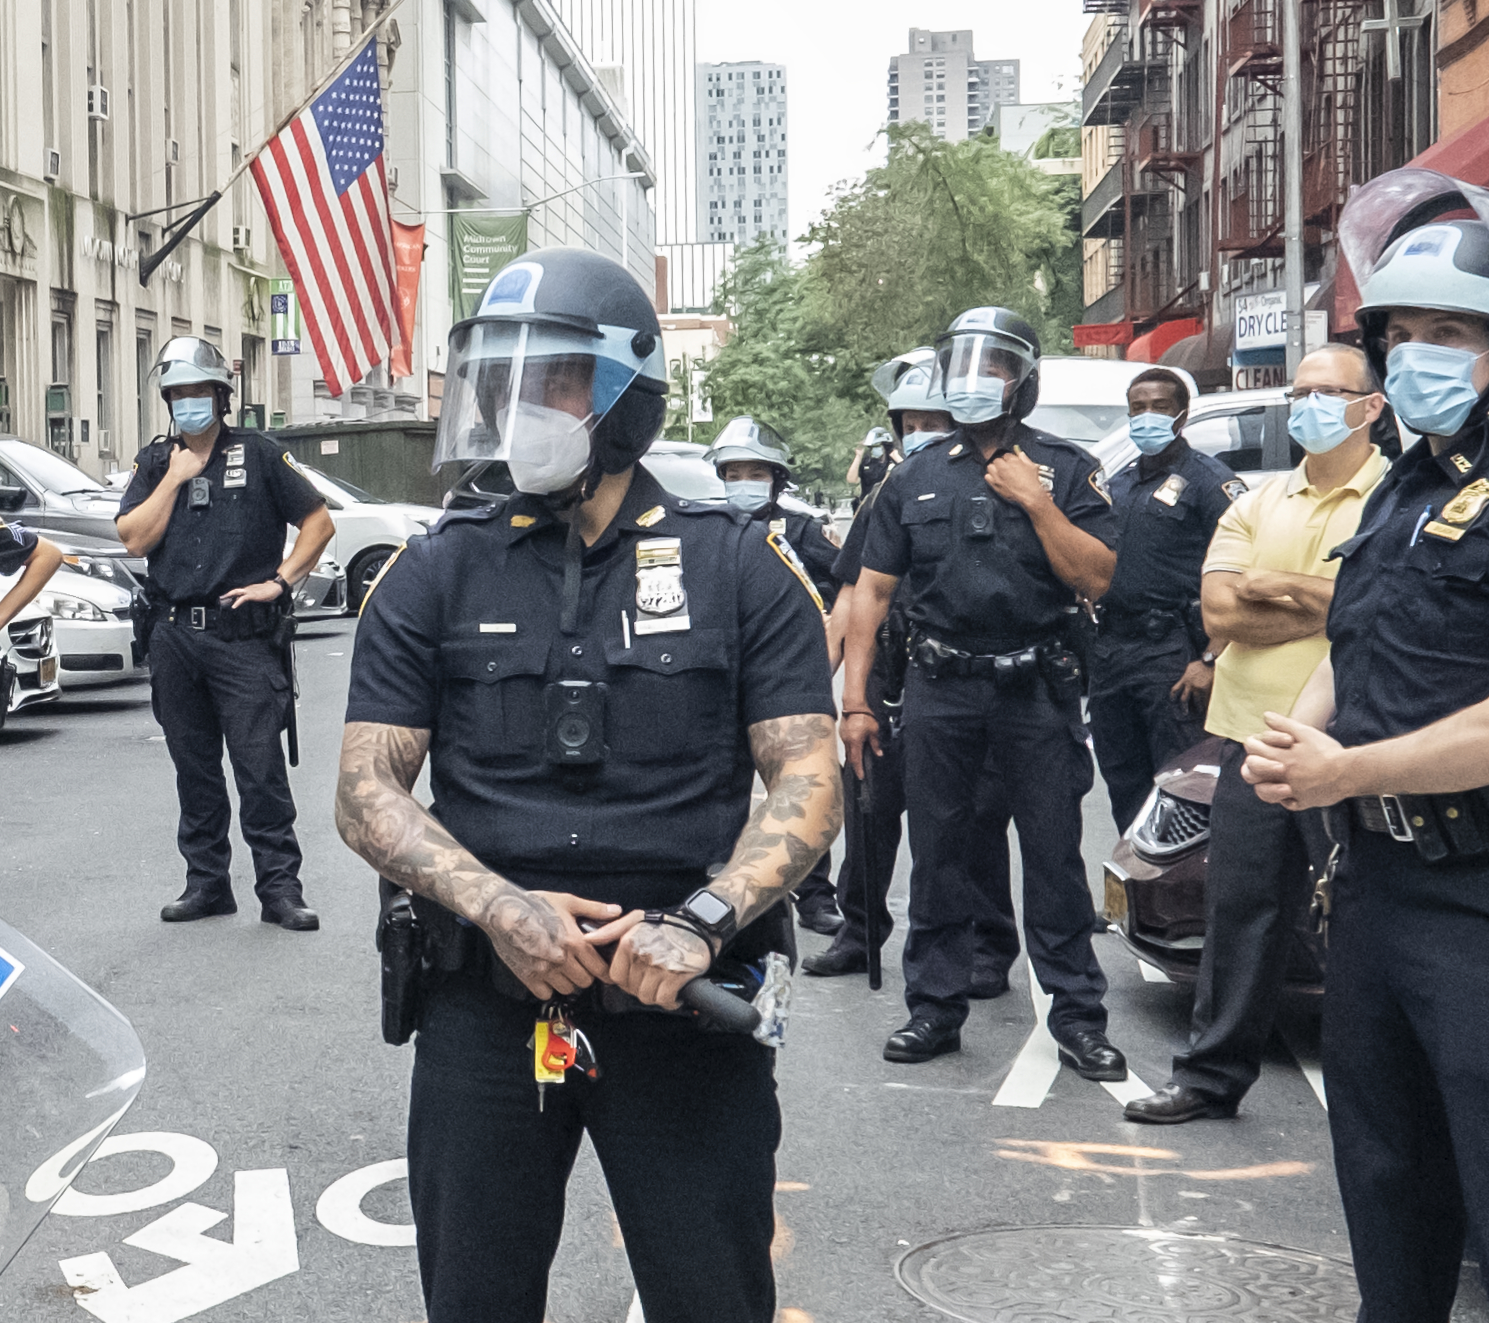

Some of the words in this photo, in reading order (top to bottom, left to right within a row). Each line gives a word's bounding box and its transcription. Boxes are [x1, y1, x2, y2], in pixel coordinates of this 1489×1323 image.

[463, 243, 518, 255] Community
[463, 254, 490, 264] Court
[1238, 313, 1264, 339] DRY
